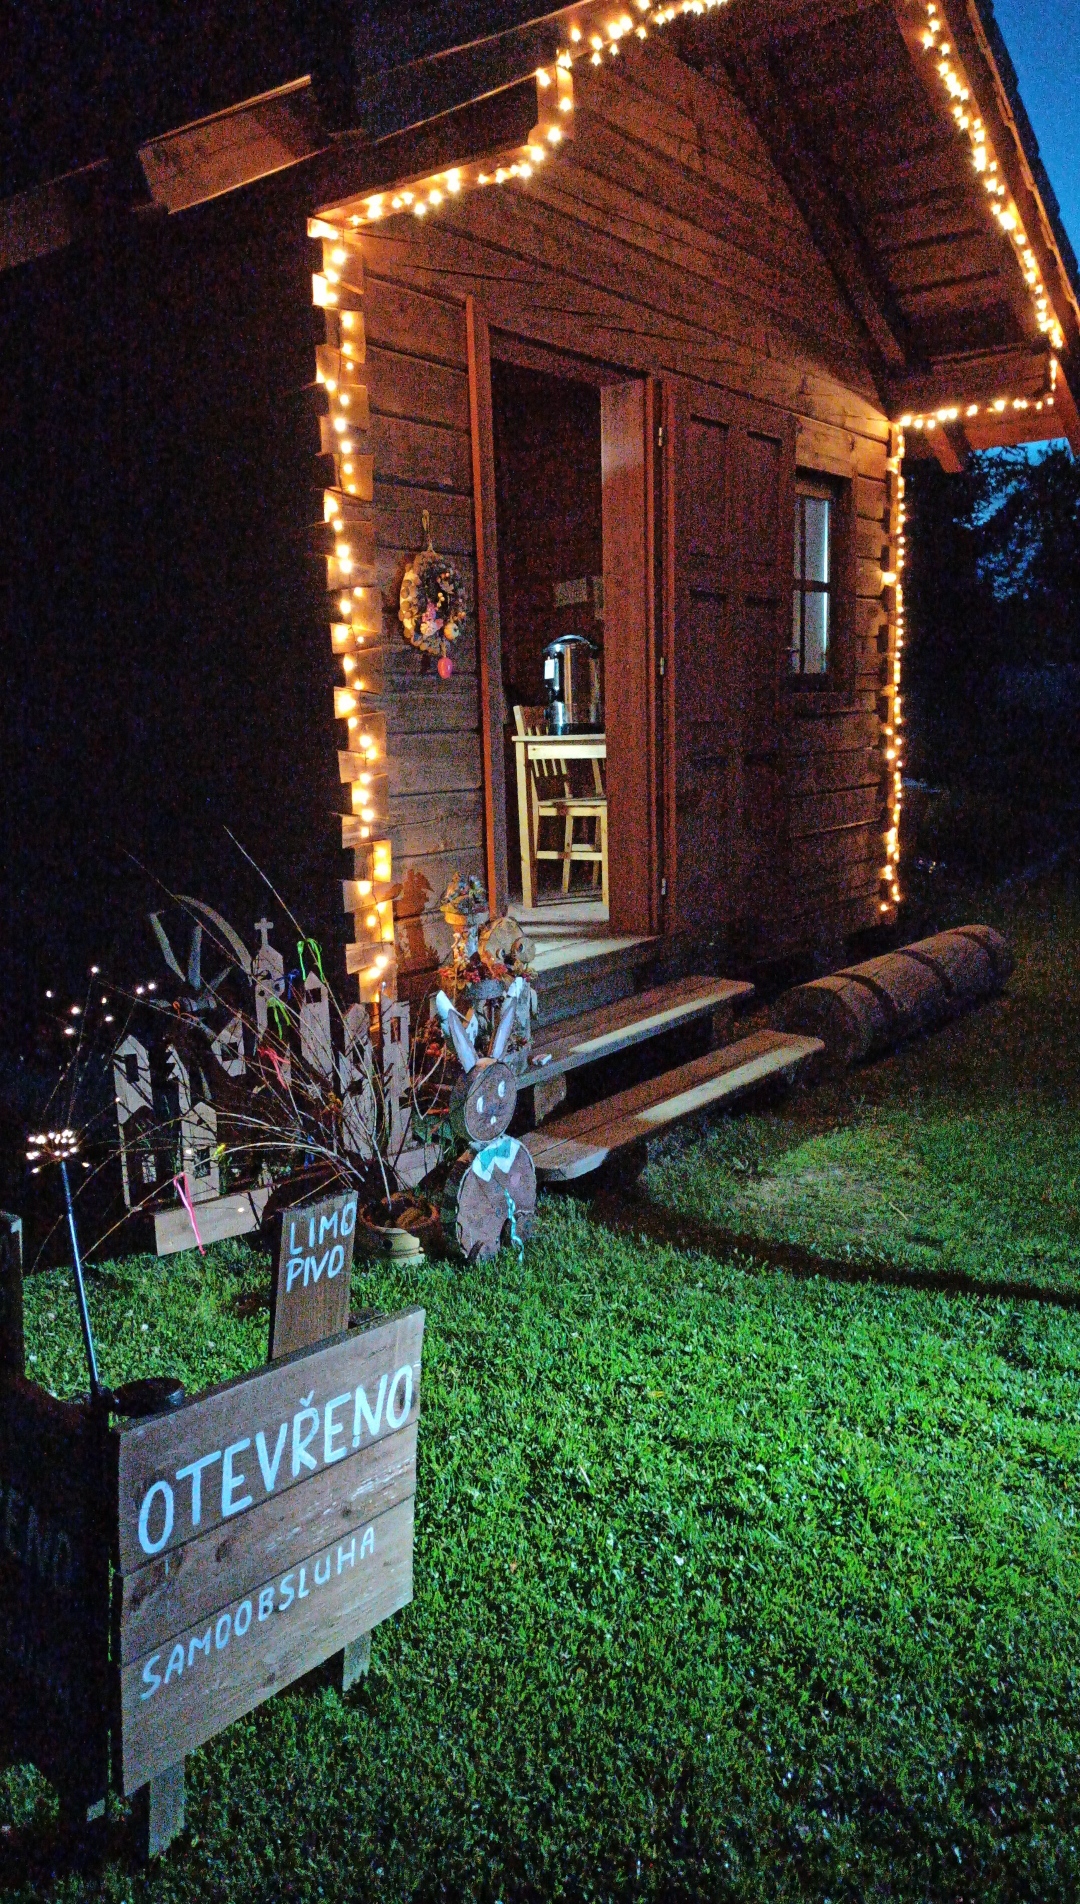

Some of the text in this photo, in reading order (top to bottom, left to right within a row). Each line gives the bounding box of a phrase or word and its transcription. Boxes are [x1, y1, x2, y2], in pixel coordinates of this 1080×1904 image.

[286, 1244, 345, 1292] PIVO
[290, 1201, 357, 1255] LIMO
[138, 1364, 413, 1554] OTEVŘENO
[140, 1526, 375, 1700] SAMOOBSLUHA
